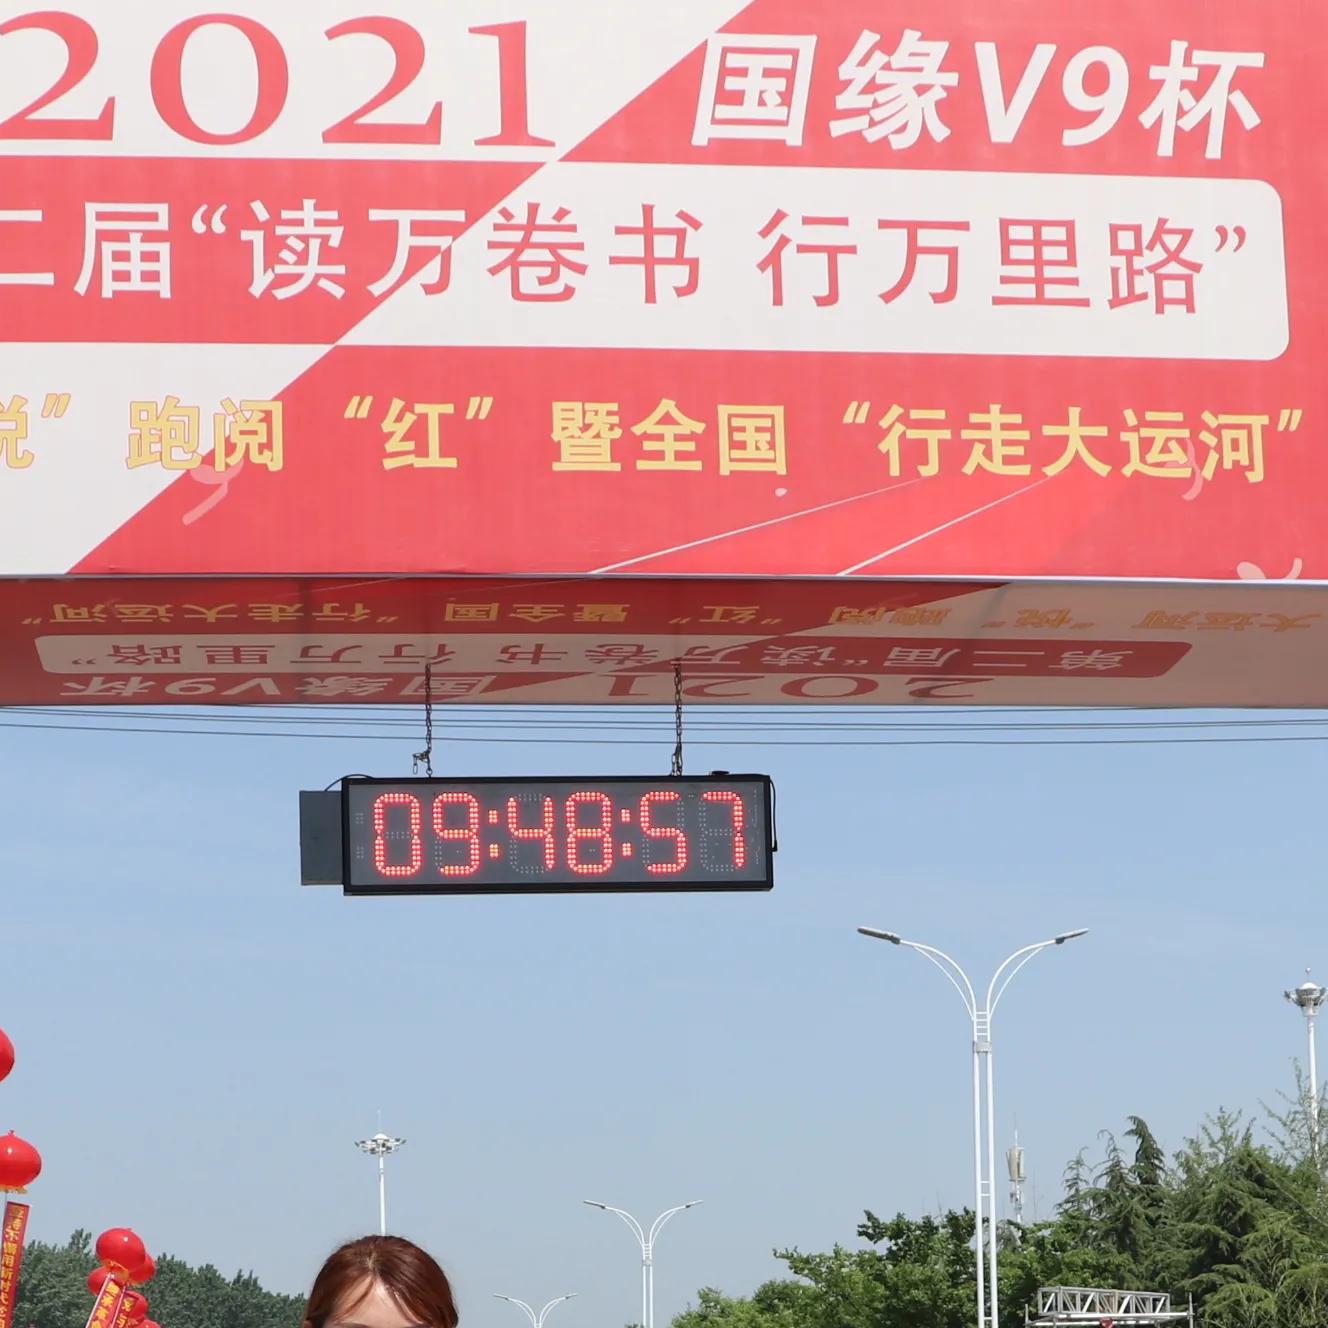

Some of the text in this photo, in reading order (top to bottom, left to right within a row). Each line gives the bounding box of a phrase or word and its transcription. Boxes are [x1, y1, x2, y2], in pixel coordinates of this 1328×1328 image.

[690, 29, 1266, 160] 国缘V9杯
[757, 208, 1248, 315] 行万里路”
[374, 791, 745, 876] 09:48:57
